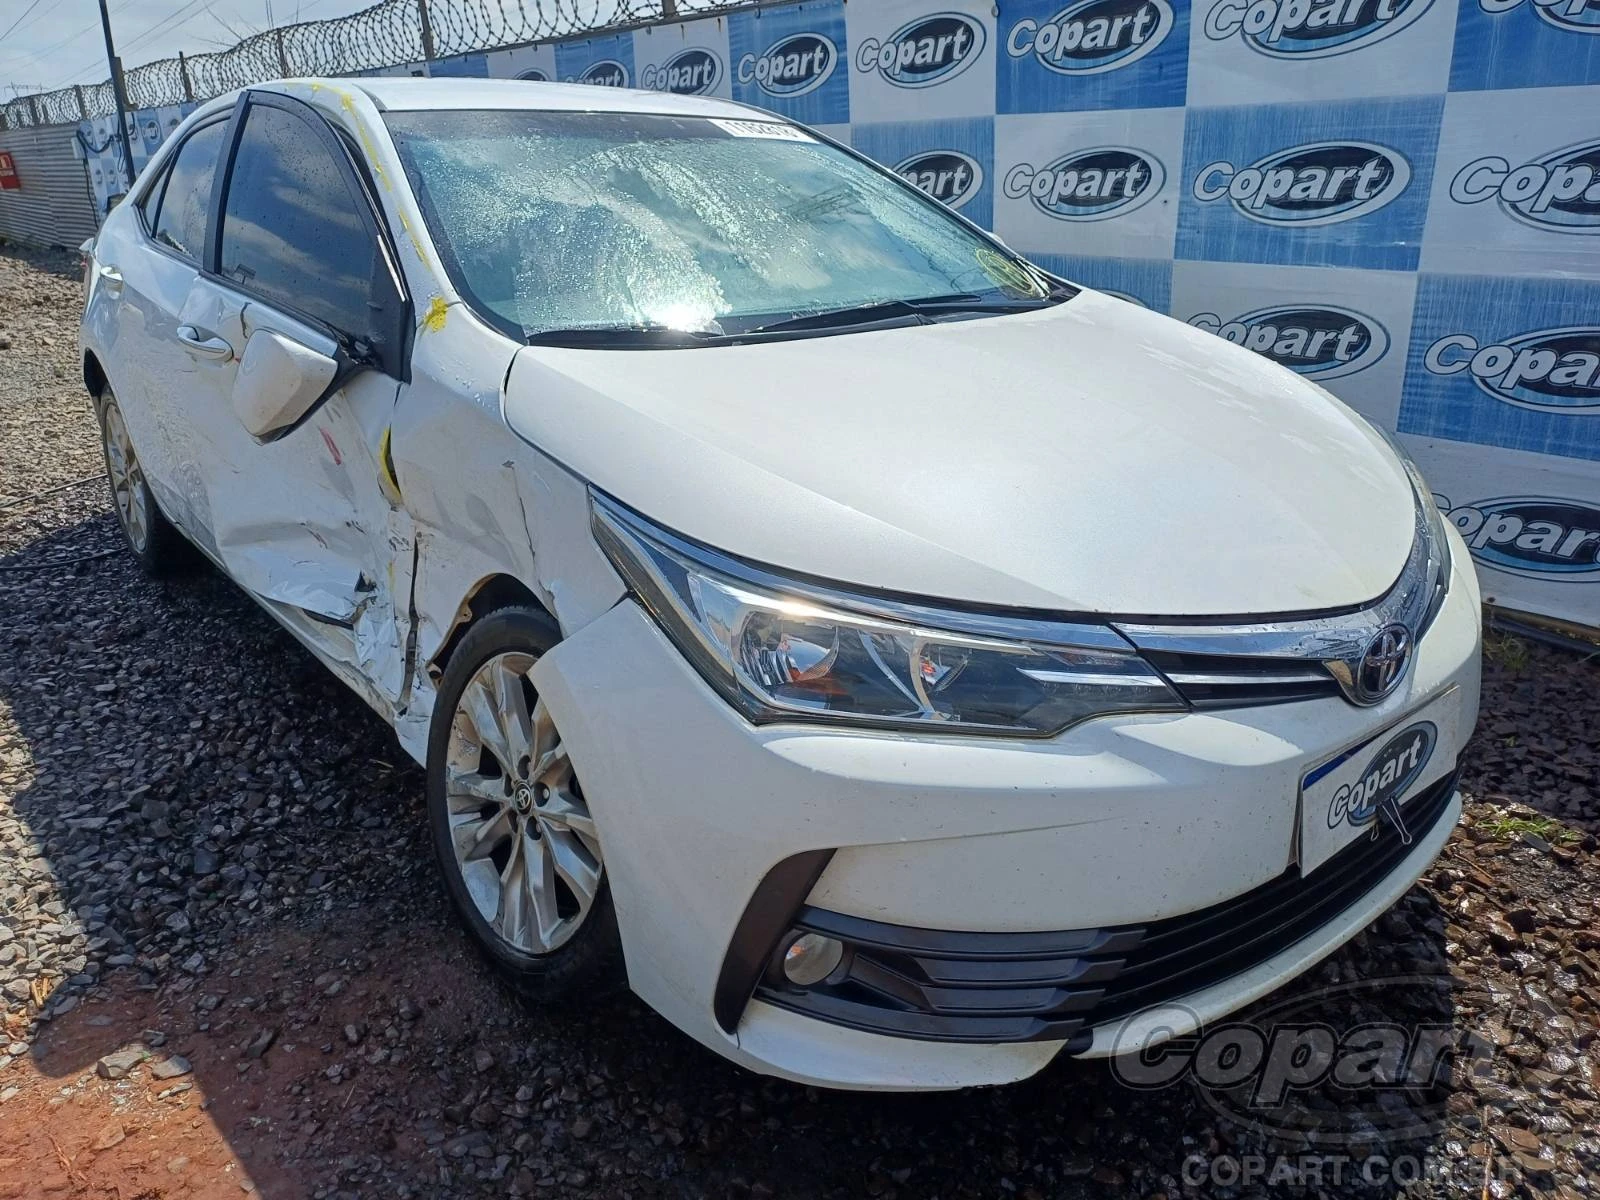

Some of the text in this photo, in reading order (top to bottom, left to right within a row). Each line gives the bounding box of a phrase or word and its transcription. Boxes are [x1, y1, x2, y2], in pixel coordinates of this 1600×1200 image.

[856, 23, 969, 75] Copart
[1007, 3, 1152, 61] Copart
[641, 57, 712, 93] Copart
[738, 42, 826, 86] Copart
[1003, 158, 1145, 206] Copart
[1193, 154, 1386, 209] Copart
[1424, 334, 1600, 390] Copa
[1431, 493, 1600, 562] opar
[1328, 734, 1422, 829] Copart
